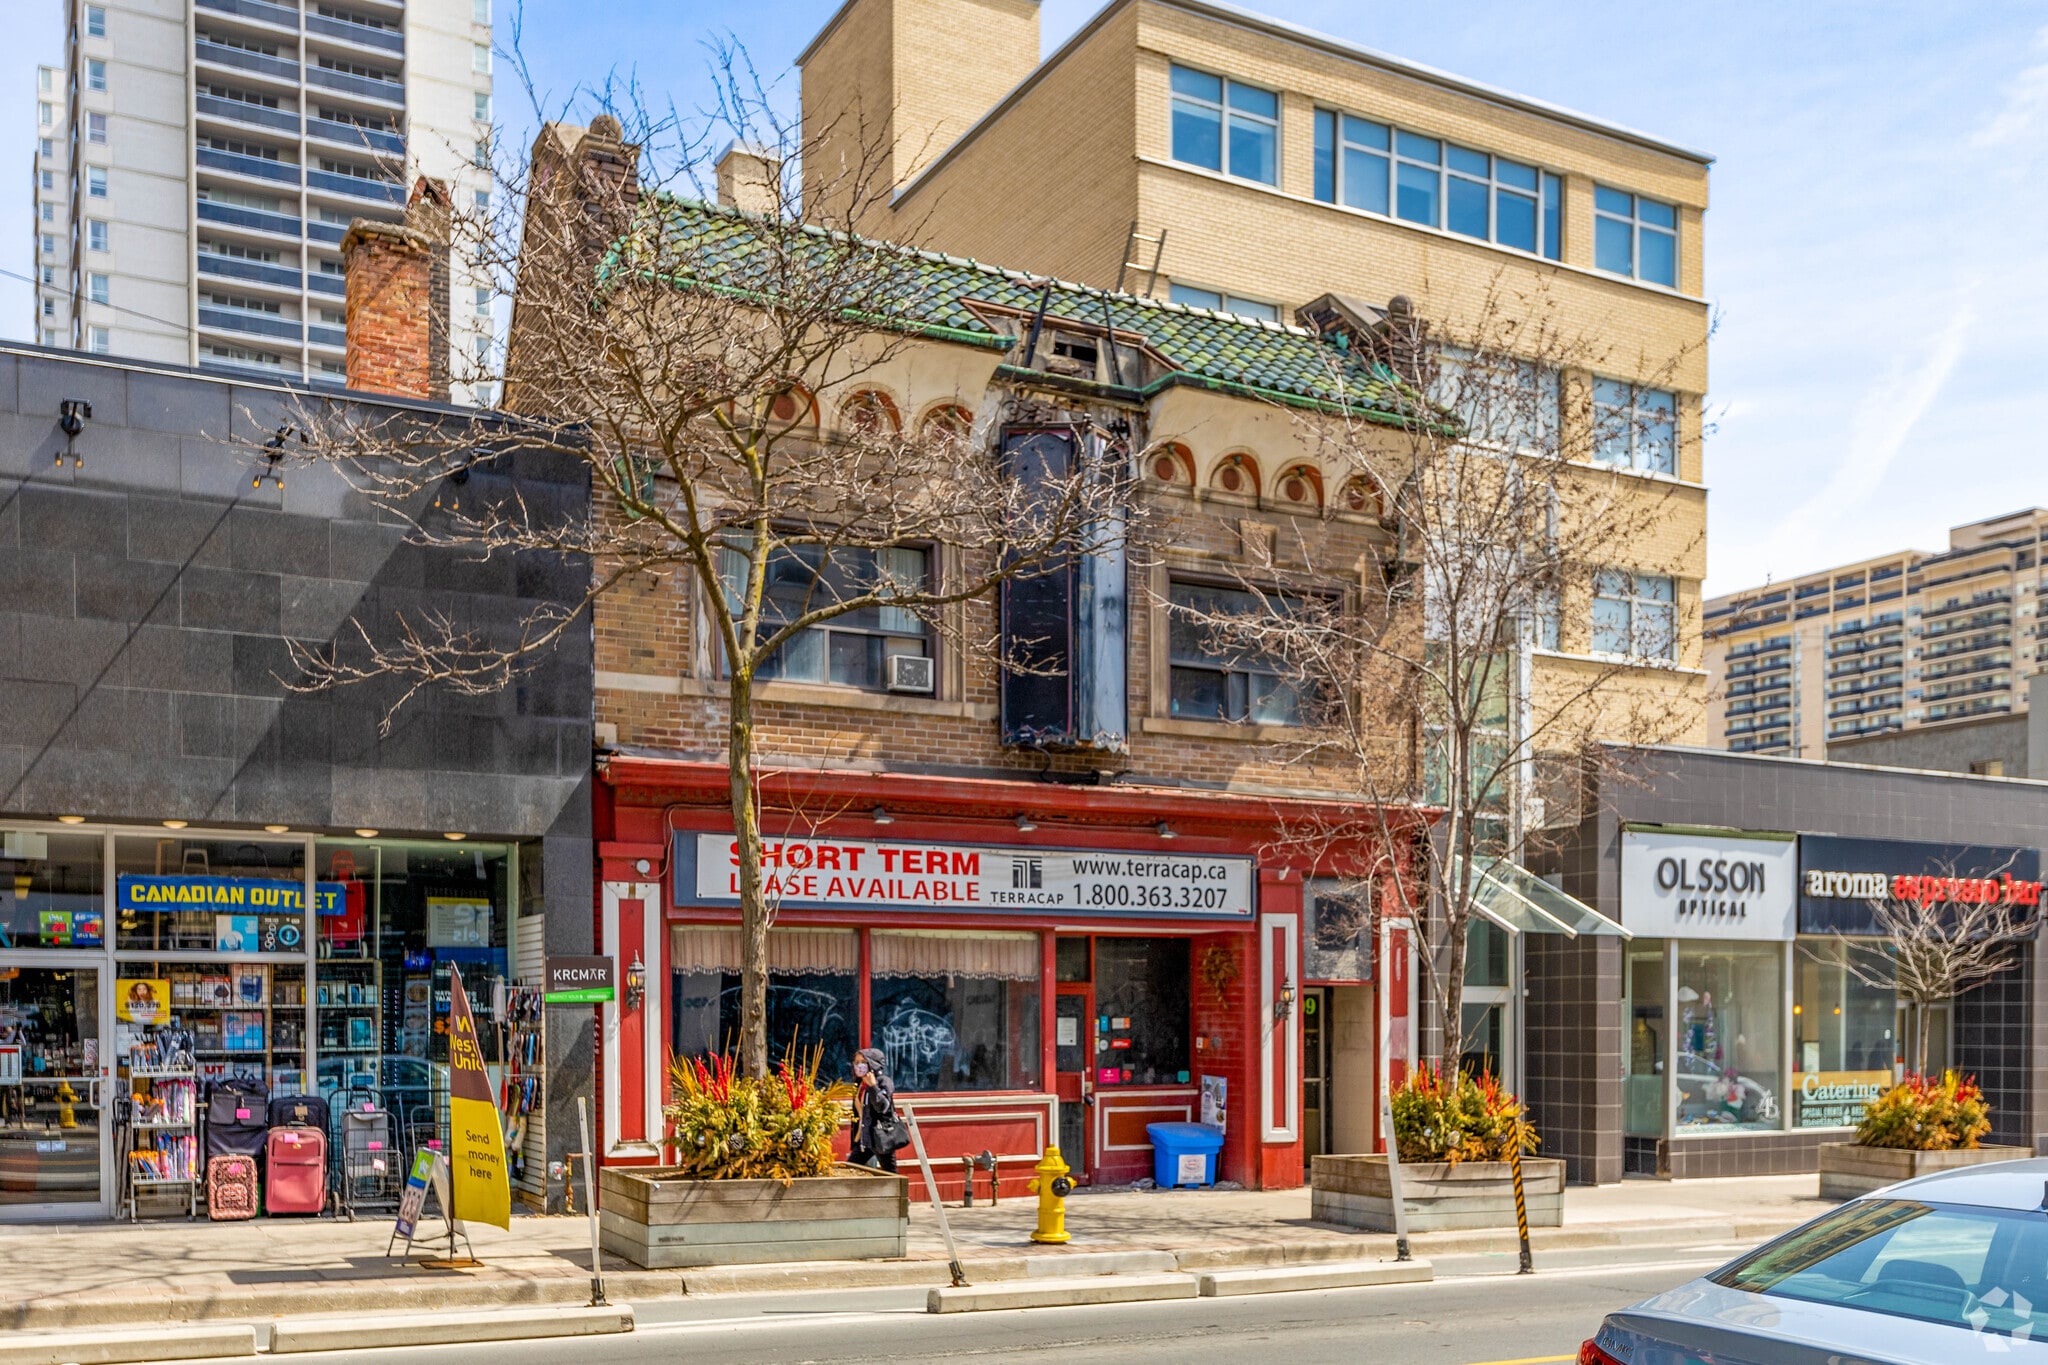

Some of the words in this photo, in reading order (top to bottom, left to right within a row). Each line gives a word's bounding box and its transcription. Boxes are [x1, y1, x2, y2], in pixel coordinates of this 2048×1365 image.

[878, 848, 980, 876] TERM
[1073, 859, 1227, 884] www.terracap.ca
[730, 872, 818, 896] LASE
[826, 876, 980, 901] AVAILABLE
[1657, 857, 1765, 893] OLSSON
[1807, 869, 1889, 899] aroma
[2004, 872, 2043, 905] bar
[131, 884, 245, 905] CANADIAN
[991, 891, 1064, 905] TERRACAP
[1073, 884, 1227, 909] 1.800.363.3207
[1679, 899, 1747, 918] OPTICAL
[1802, 1074, 1880, 1104] Catering
[465, 1129, 490, 1145] Send
[468, 1150, 500, 1167] money
[469, 1164, 493, 1180] here
